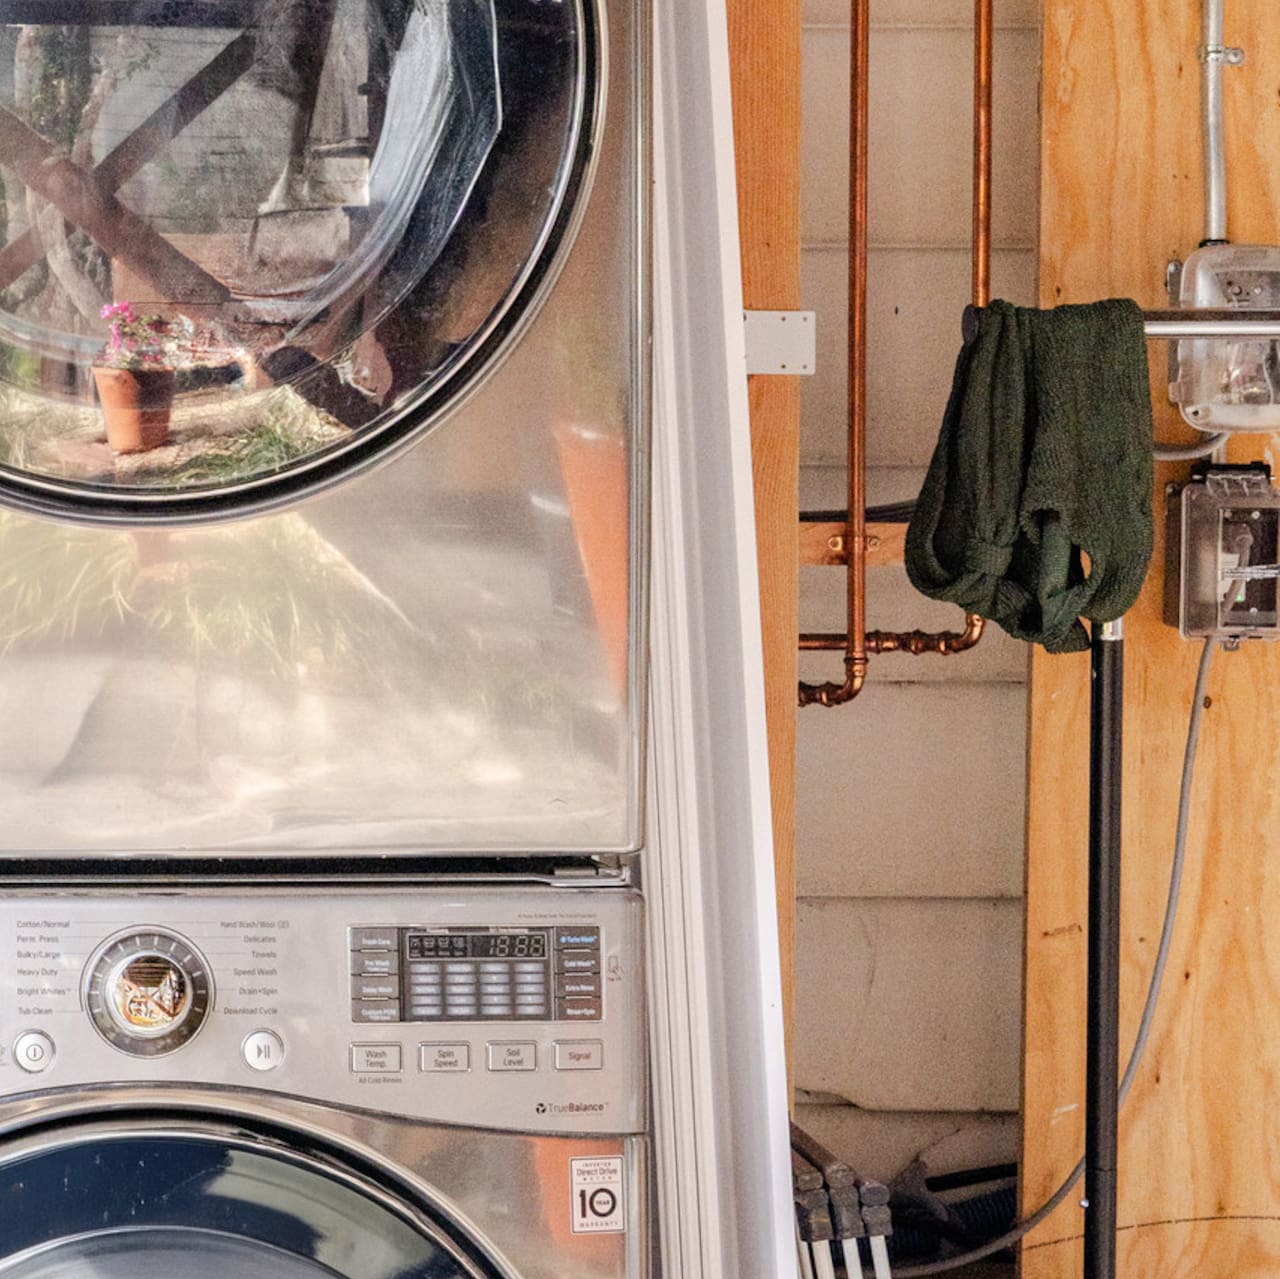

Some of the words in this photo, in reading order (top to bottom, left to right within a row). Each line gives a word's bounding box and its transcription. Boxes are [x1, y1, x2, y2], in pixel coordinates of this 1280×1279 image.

[17, 951, 61, 960] Bulky/Large
[17, 968, 40, 976] Heavy
[41, 968, 59, 976] Duty
[223, 1007, 257, 1016] Download
[258, 1007, 278, 1016] Cycle
[365, 1050, 388, 1059] Wash
[437, 1049, 455, 1059] Spin
[506, 1048, 521, 1057] Soil
[568, 1051, 591, 1061] Signal
[433, 1059, 459, 1069] Speed
[503, 1058, 524, 1067] Level
[576, 1168, 598, 1177] Direct
[599, 1167, 618, 1176] Drive
[579, 1188, 617, 1219] 10
